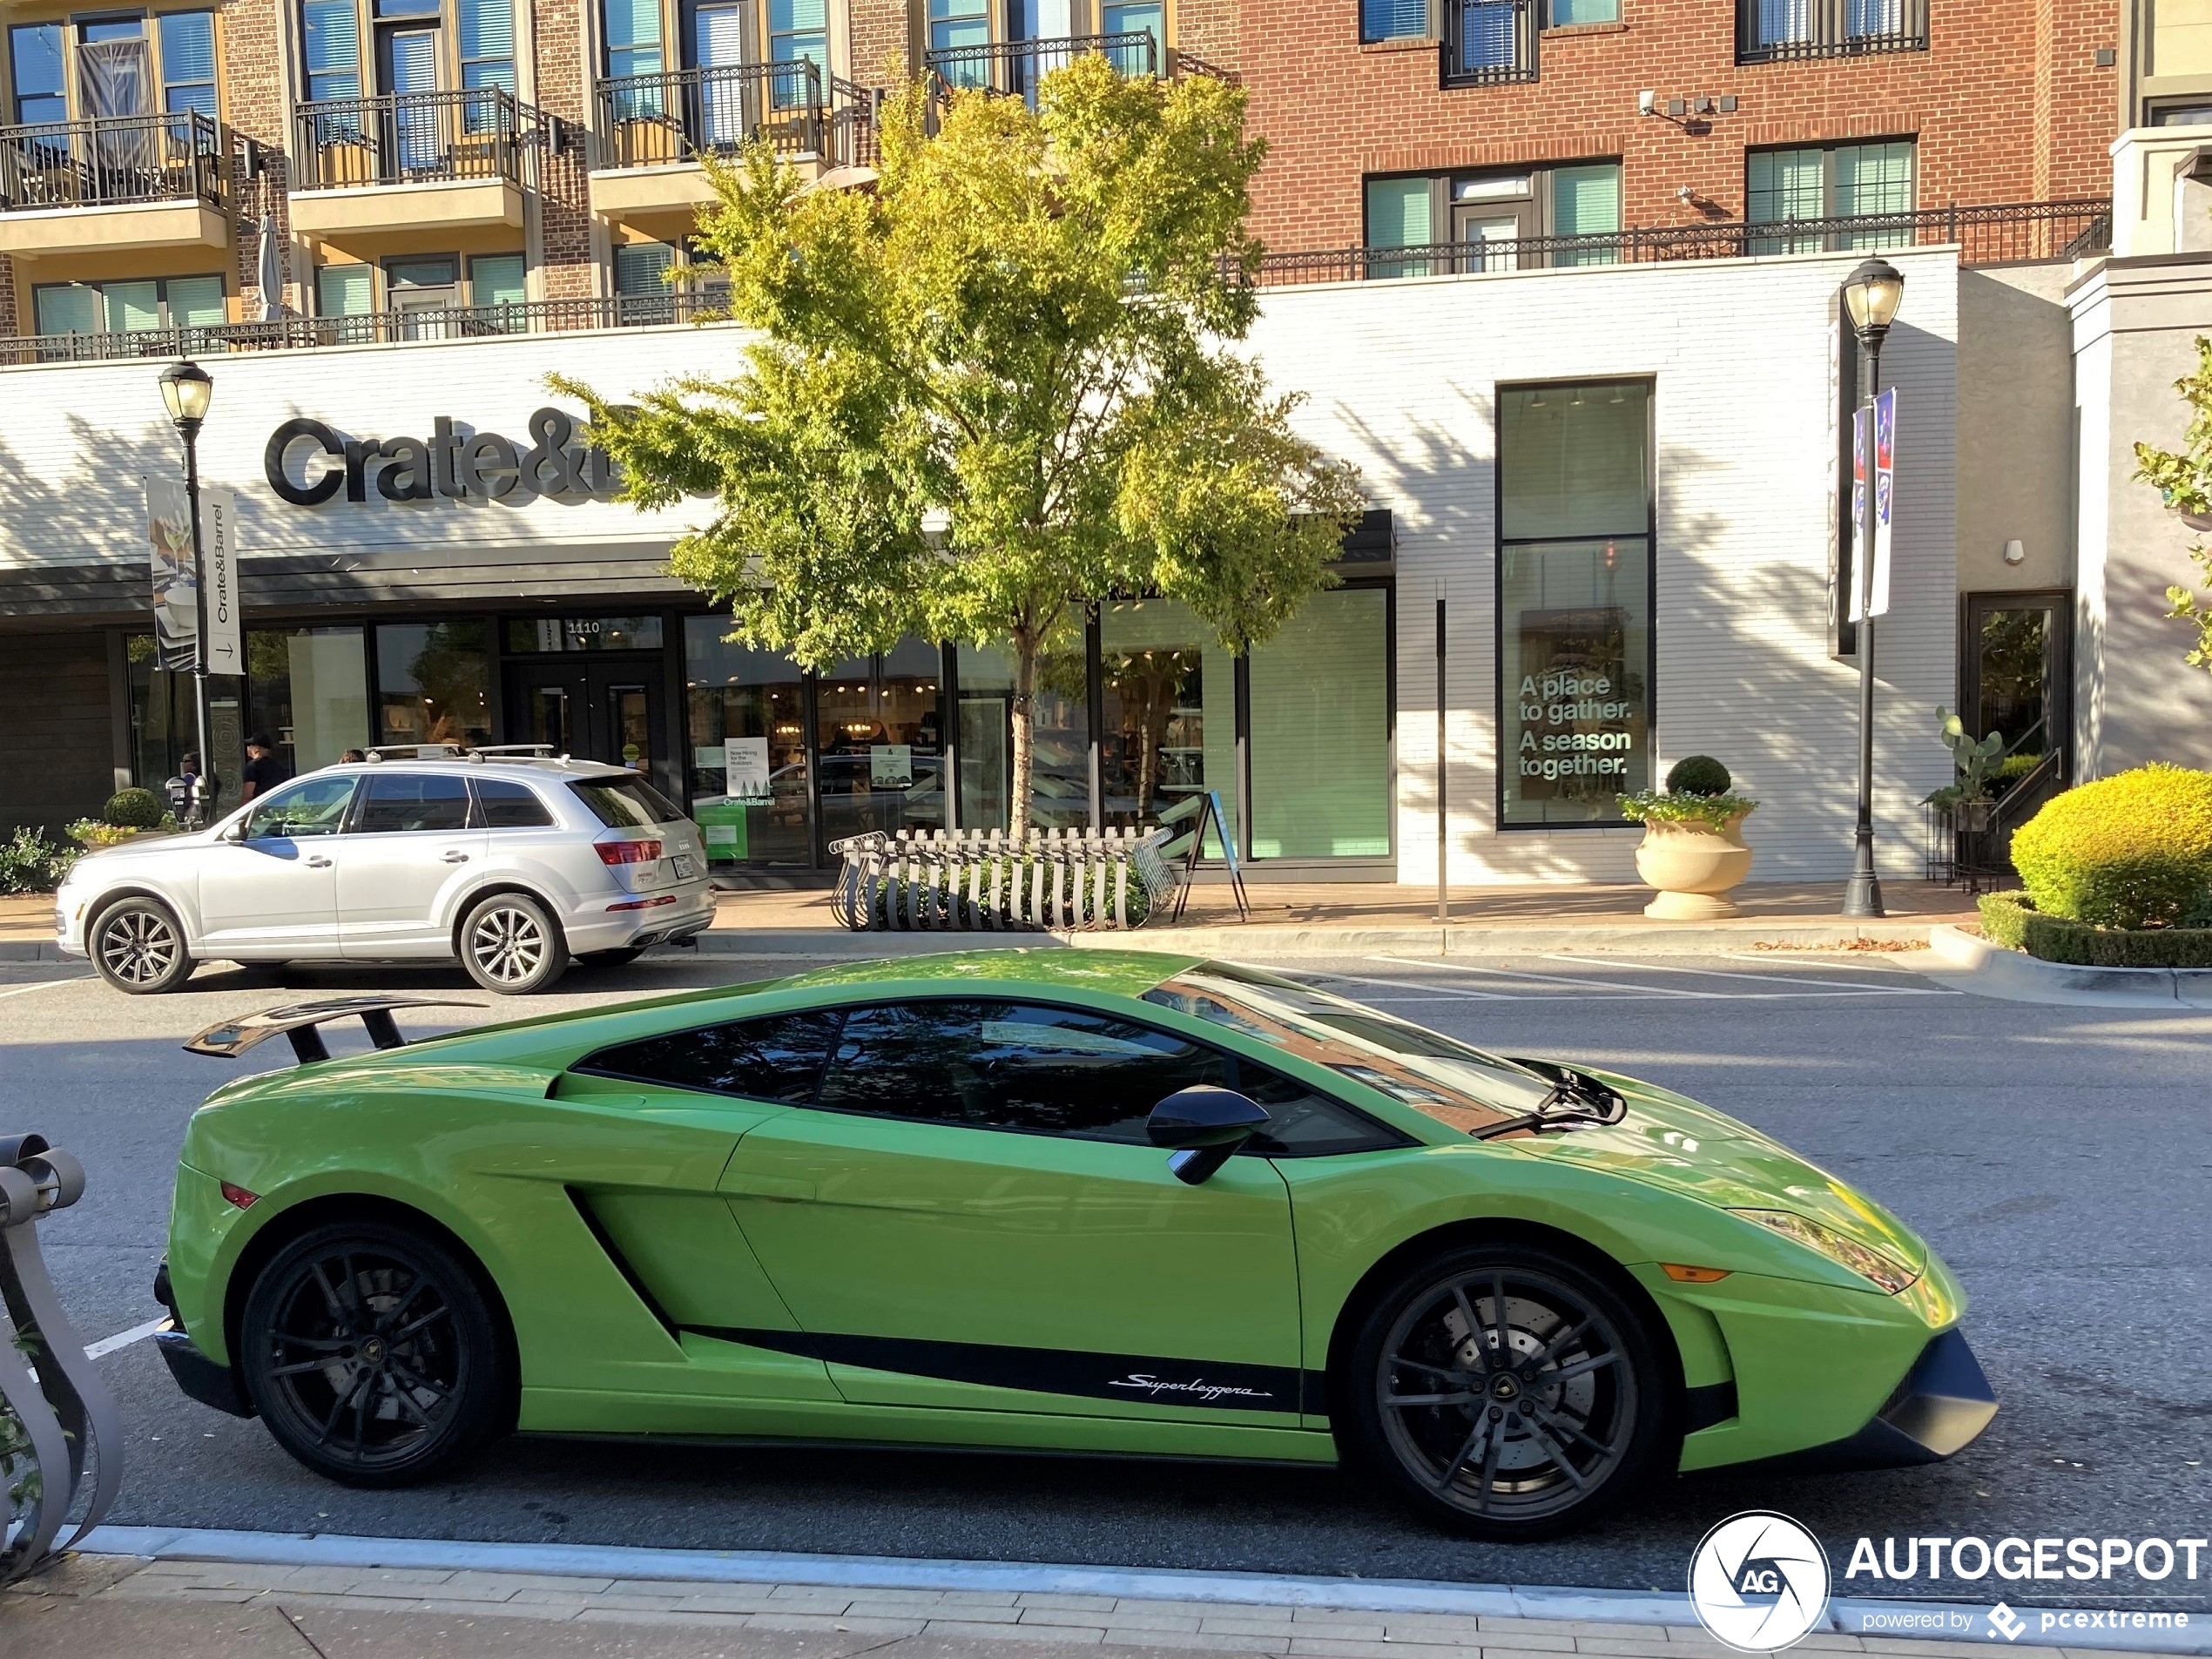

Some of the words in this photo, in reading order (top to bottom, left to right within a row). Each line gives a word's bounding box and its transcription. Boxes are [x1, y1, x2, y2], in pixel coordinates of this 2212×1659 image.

[212, 503, 227, 624] Crate&Barrel
[569, 622, 599, 633] 1110
[1519, 675, 1538, 696] A
[1542, 674, 1611, 701] place
[1519, 701, 1543, 721] to
[1548, 698, 1632, 725] gather.
[1519, 730, 1538, 752] A
[1542, 732, 1631, 752] season
[1519, 753, 1628, 780] together.
[724, 797, 775, 806] Crate&Barrel
[1108, 1374, 1273, 1400] Superleggera
